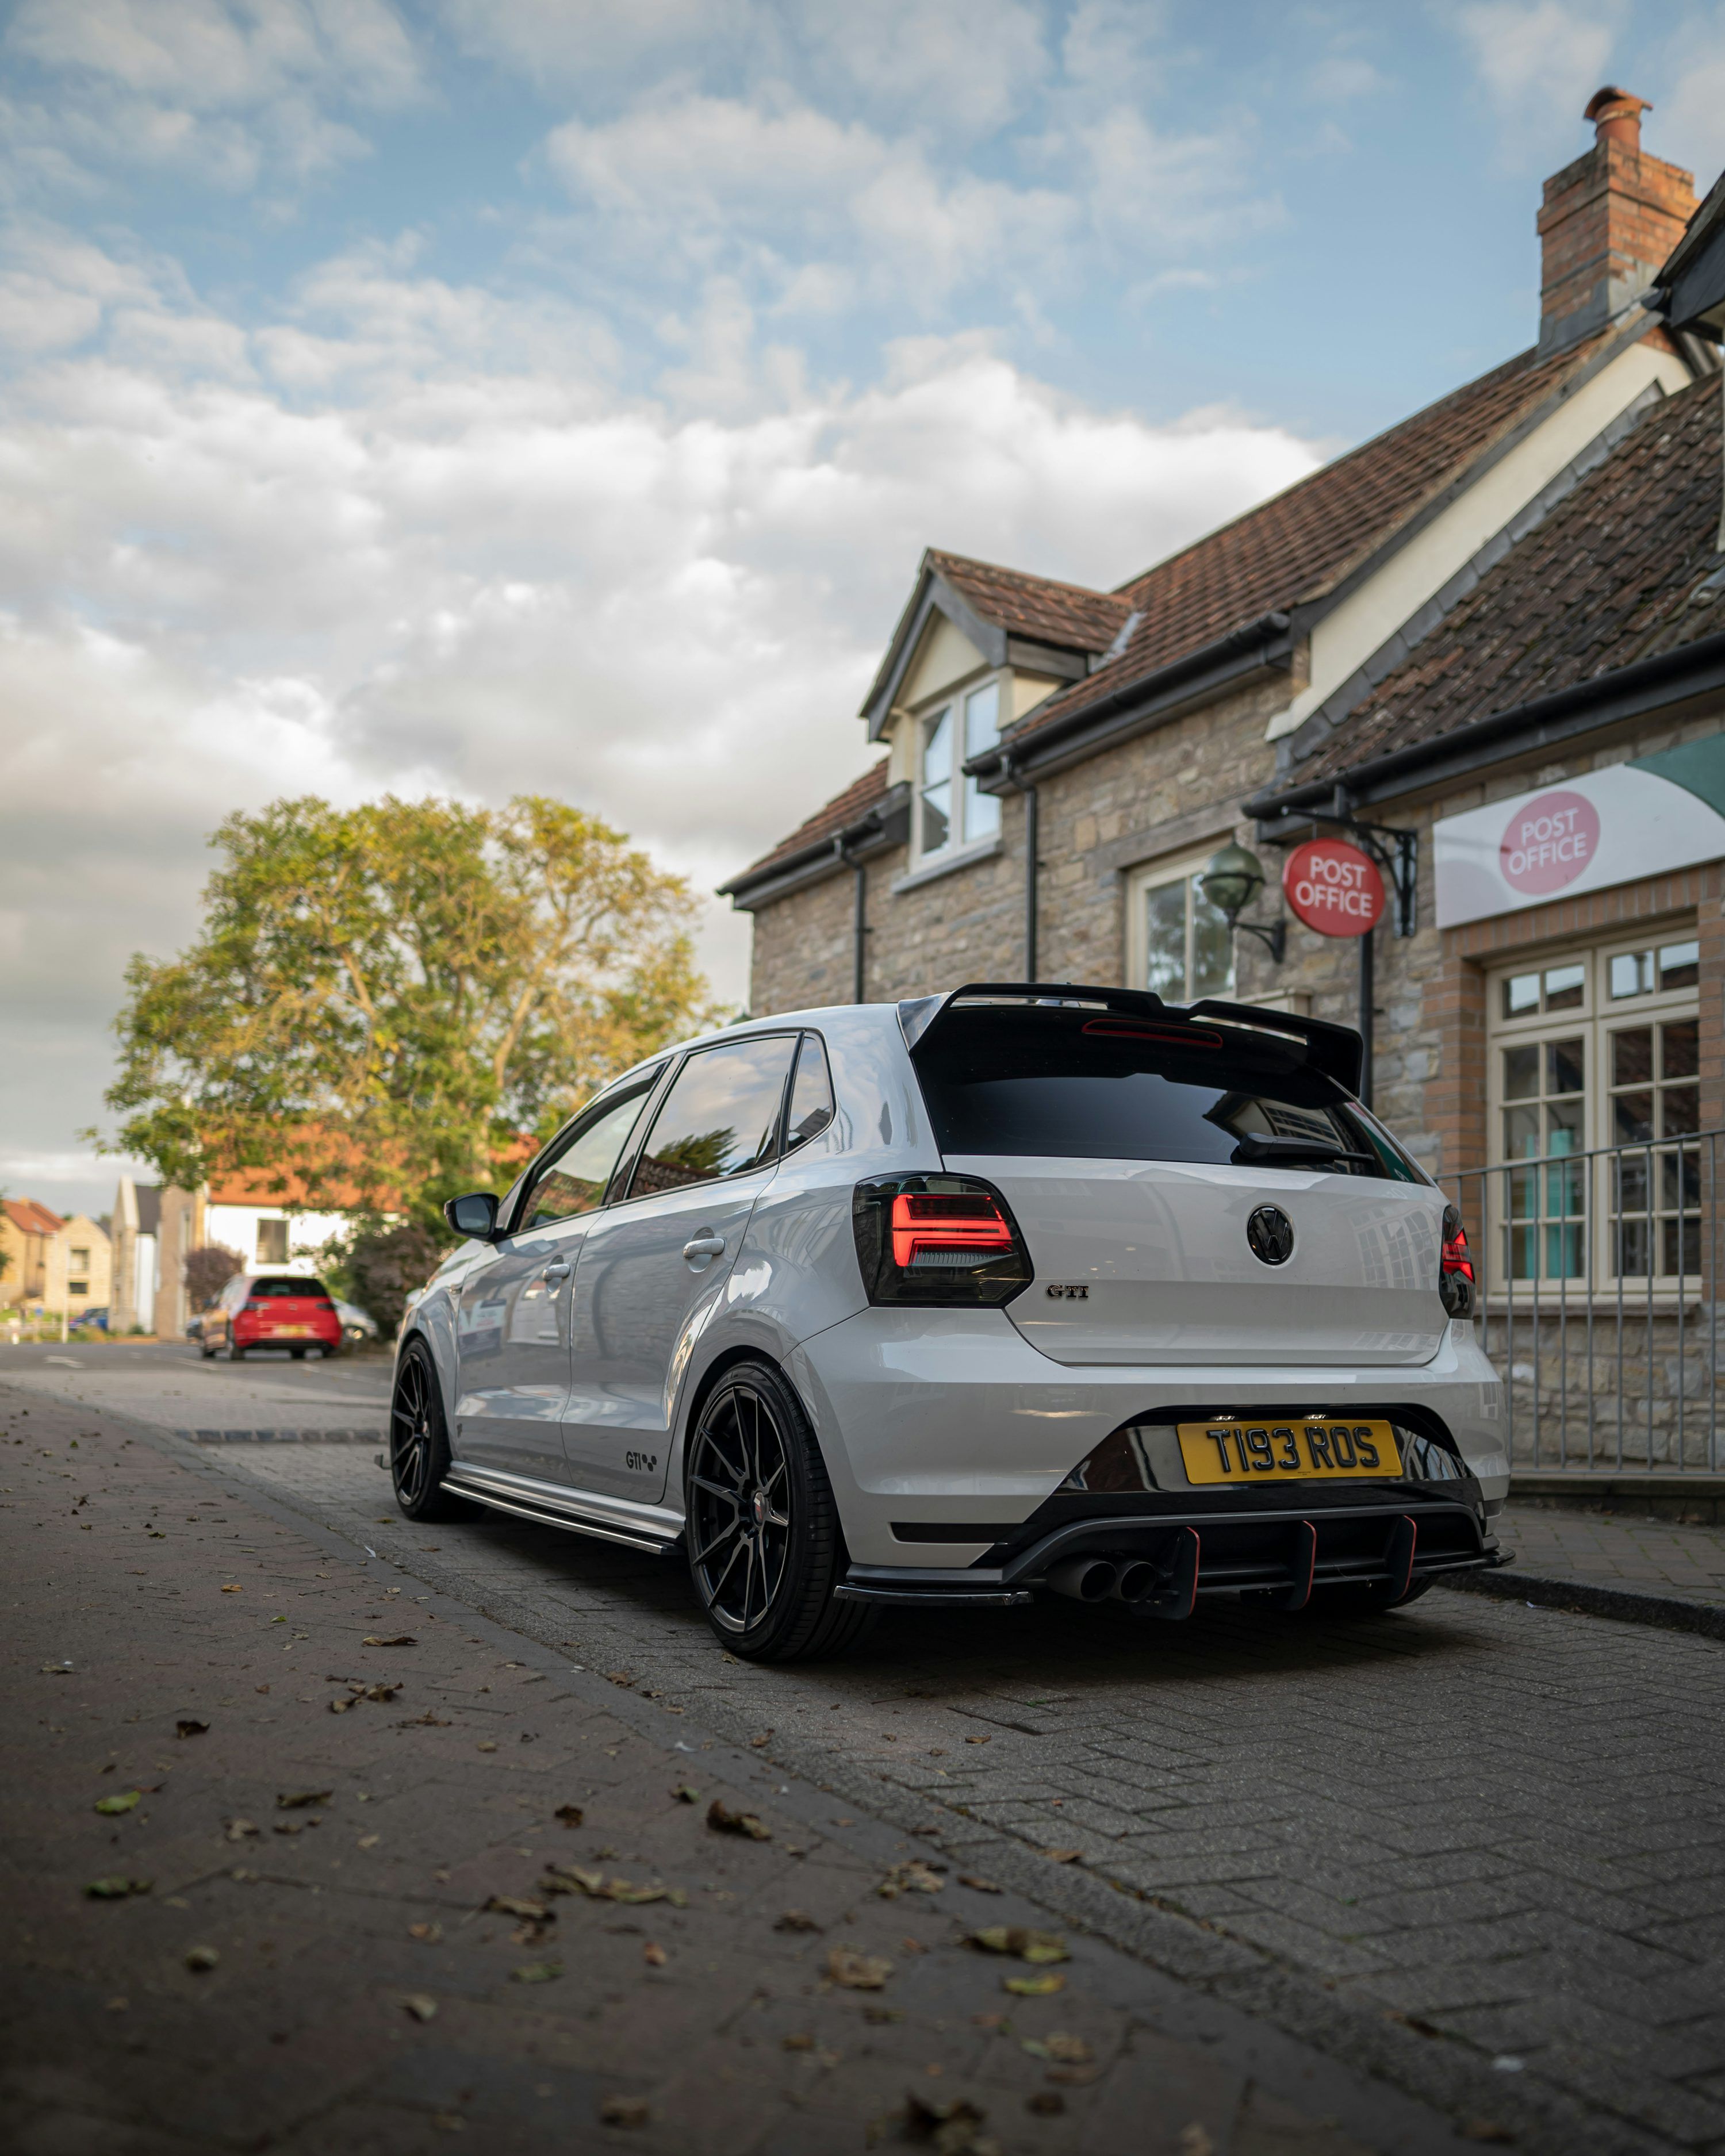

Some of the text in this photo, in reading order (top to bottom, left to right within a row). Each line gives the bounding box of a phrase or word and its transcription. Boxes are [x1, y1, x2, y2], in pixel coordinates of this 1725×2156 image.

[1521, 808, 1579, 846] POST
[1310, 856, 1366, 889] POST
[1508, 833, 1588, 876] OFFICE
[1295, 881, 1373, 918] OFFICE
[1046, 1284, 1089, 1298] GTI
[626, 1451, 642, 1471] GTI
[1304, 1426, 1380, 1468] ROS
